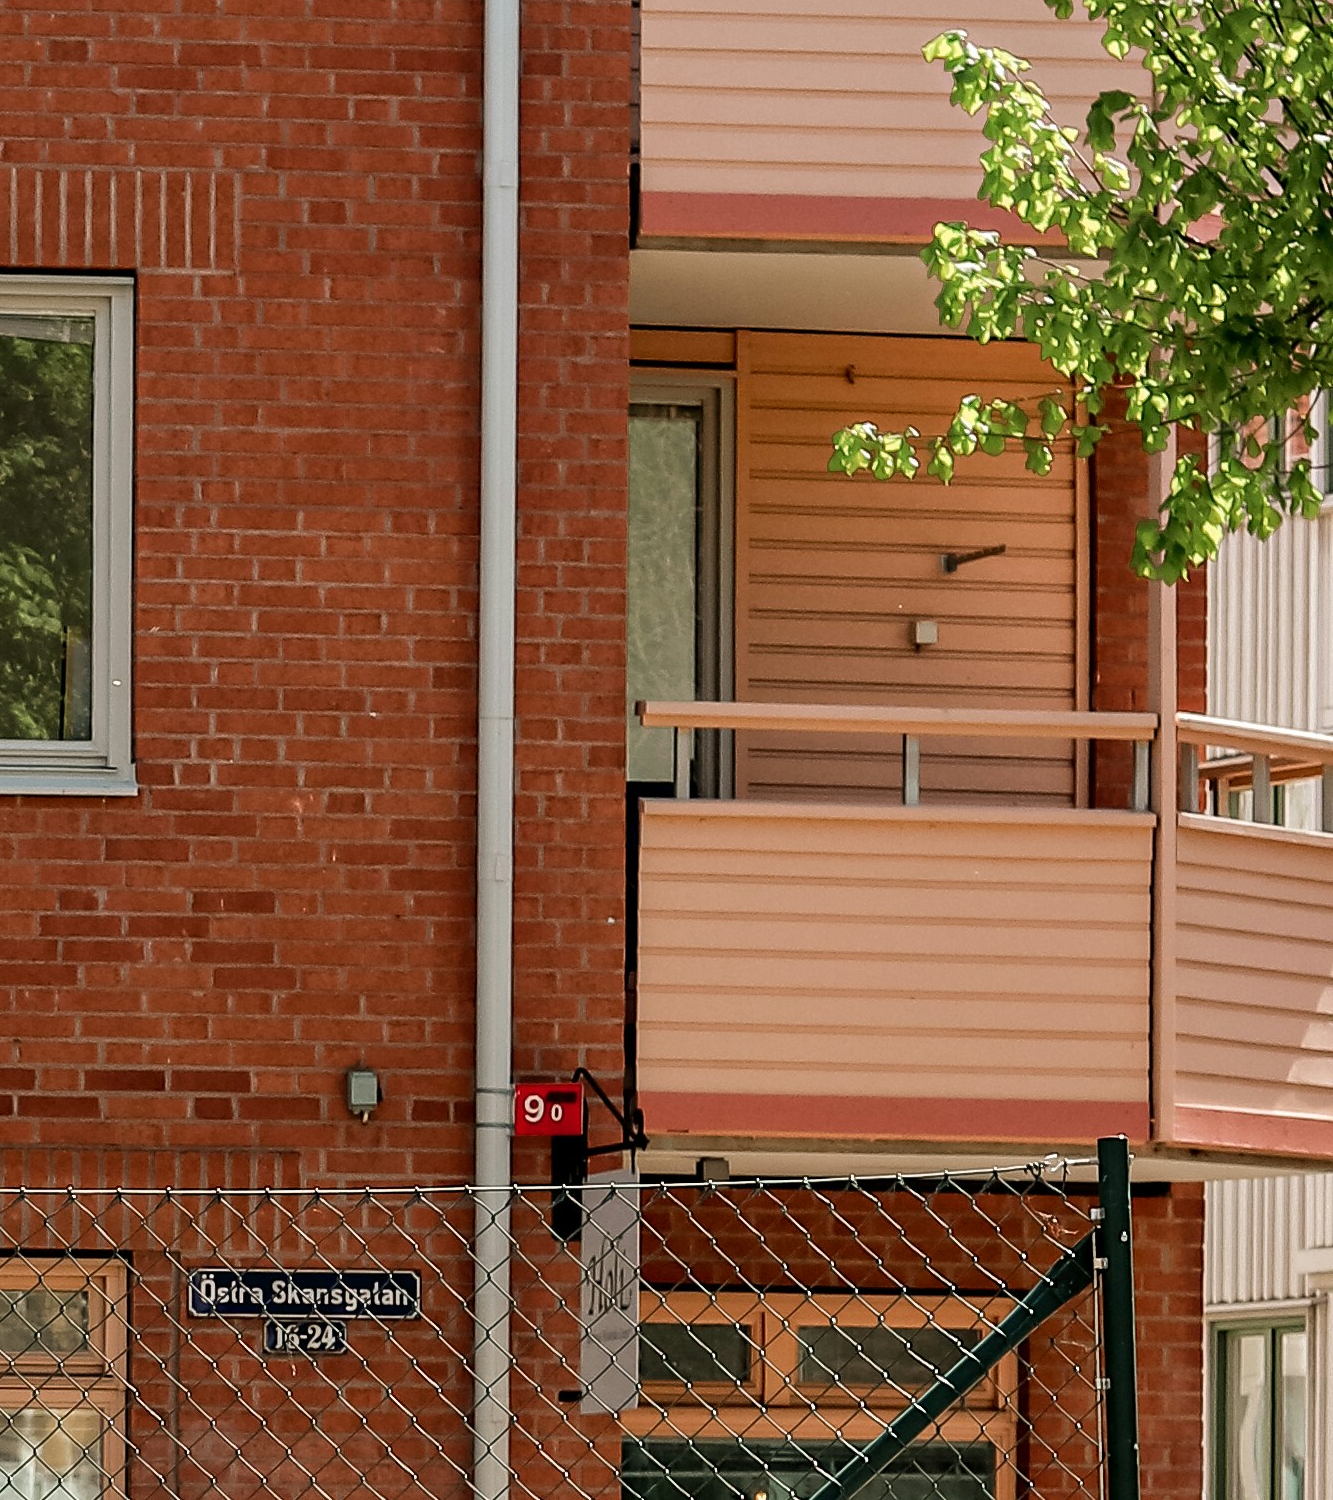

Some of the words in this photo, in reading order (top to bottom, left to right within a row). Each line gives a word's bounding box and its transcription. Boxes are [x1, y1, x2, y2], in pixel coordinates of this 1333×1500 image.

[200, 1273, 264, 1305] Östra
[271, 1279, 409, 1312] Skansgatan
[274, 1324, 336, 1350] 16-24
